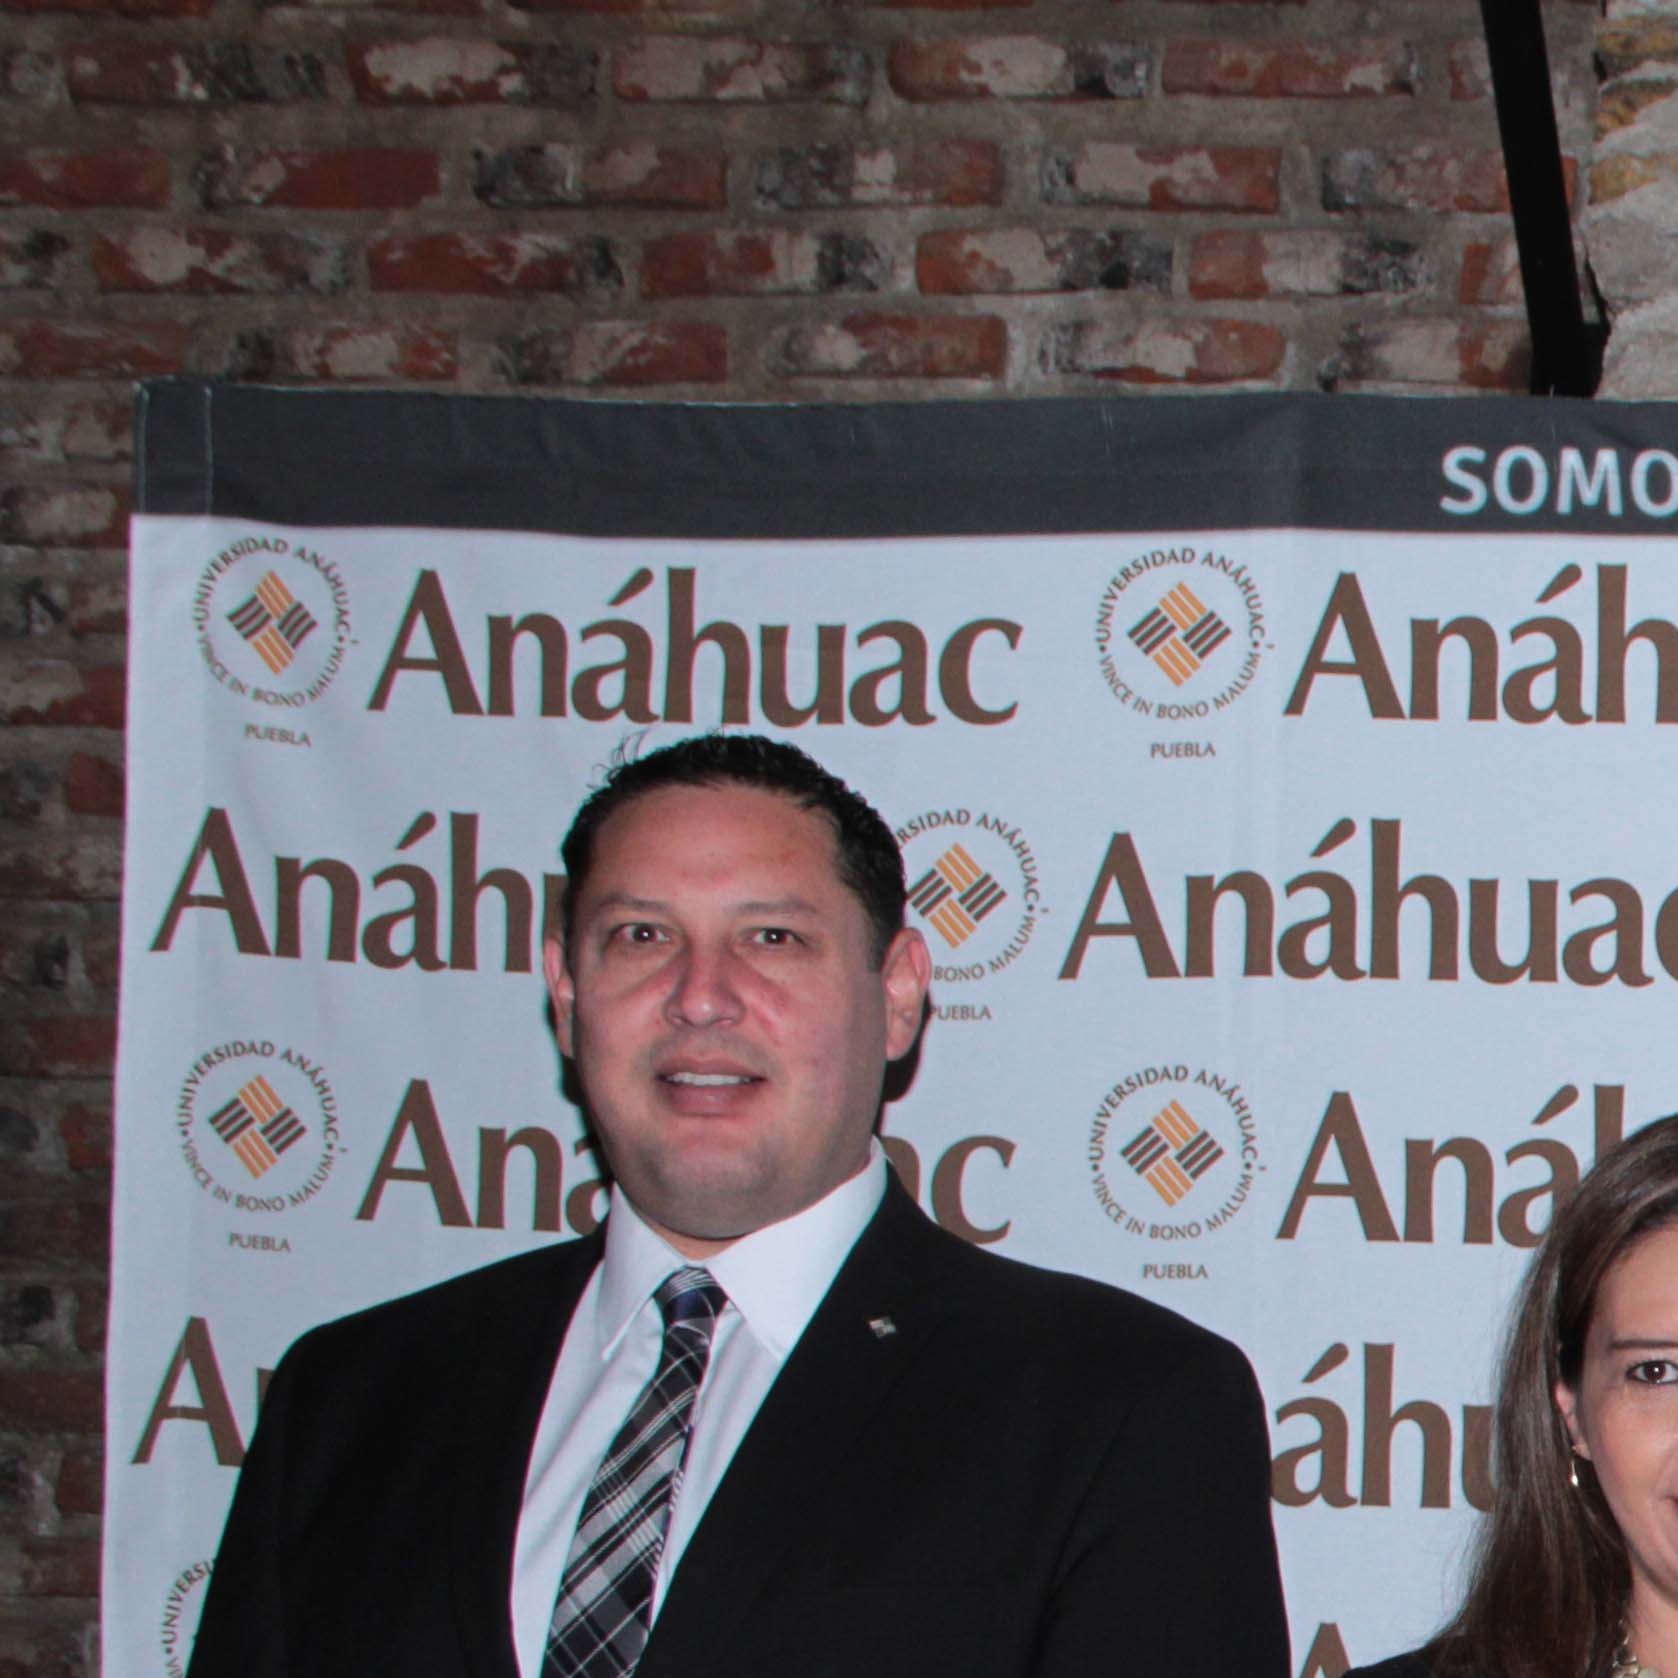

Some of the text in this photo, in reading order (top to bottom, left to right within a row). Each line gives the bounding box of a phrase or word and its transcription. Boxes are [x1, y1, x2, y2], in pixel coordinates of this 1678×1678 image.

[1094, 546, 1266, 644] UNIVERSIDAD ANÁHUAC
[367, 568, 1022, 727] Anáhuac
[1097, 651, 1262, 720] VINCE IN BONO MALUM
[1149, 741, 1217, 760] PUEBLA
[149, 806, 568, 975] Anáh
[177, 1039, 340, 1141] UNIVERSIDAD ANÁHUAC
[1087, 1064, 1259, 1162] UNIVERSIDAD ANÁHUAC
[179, 1137, 335, 1213] VINCE IN BONO MALUM
[1090, 1171, 1254, 1241] VINCE IN BONO MALUM
[227, 1231, 292, 1253] PUEBLA
[1141, 1262, 1209, 1281] PUEBLA
